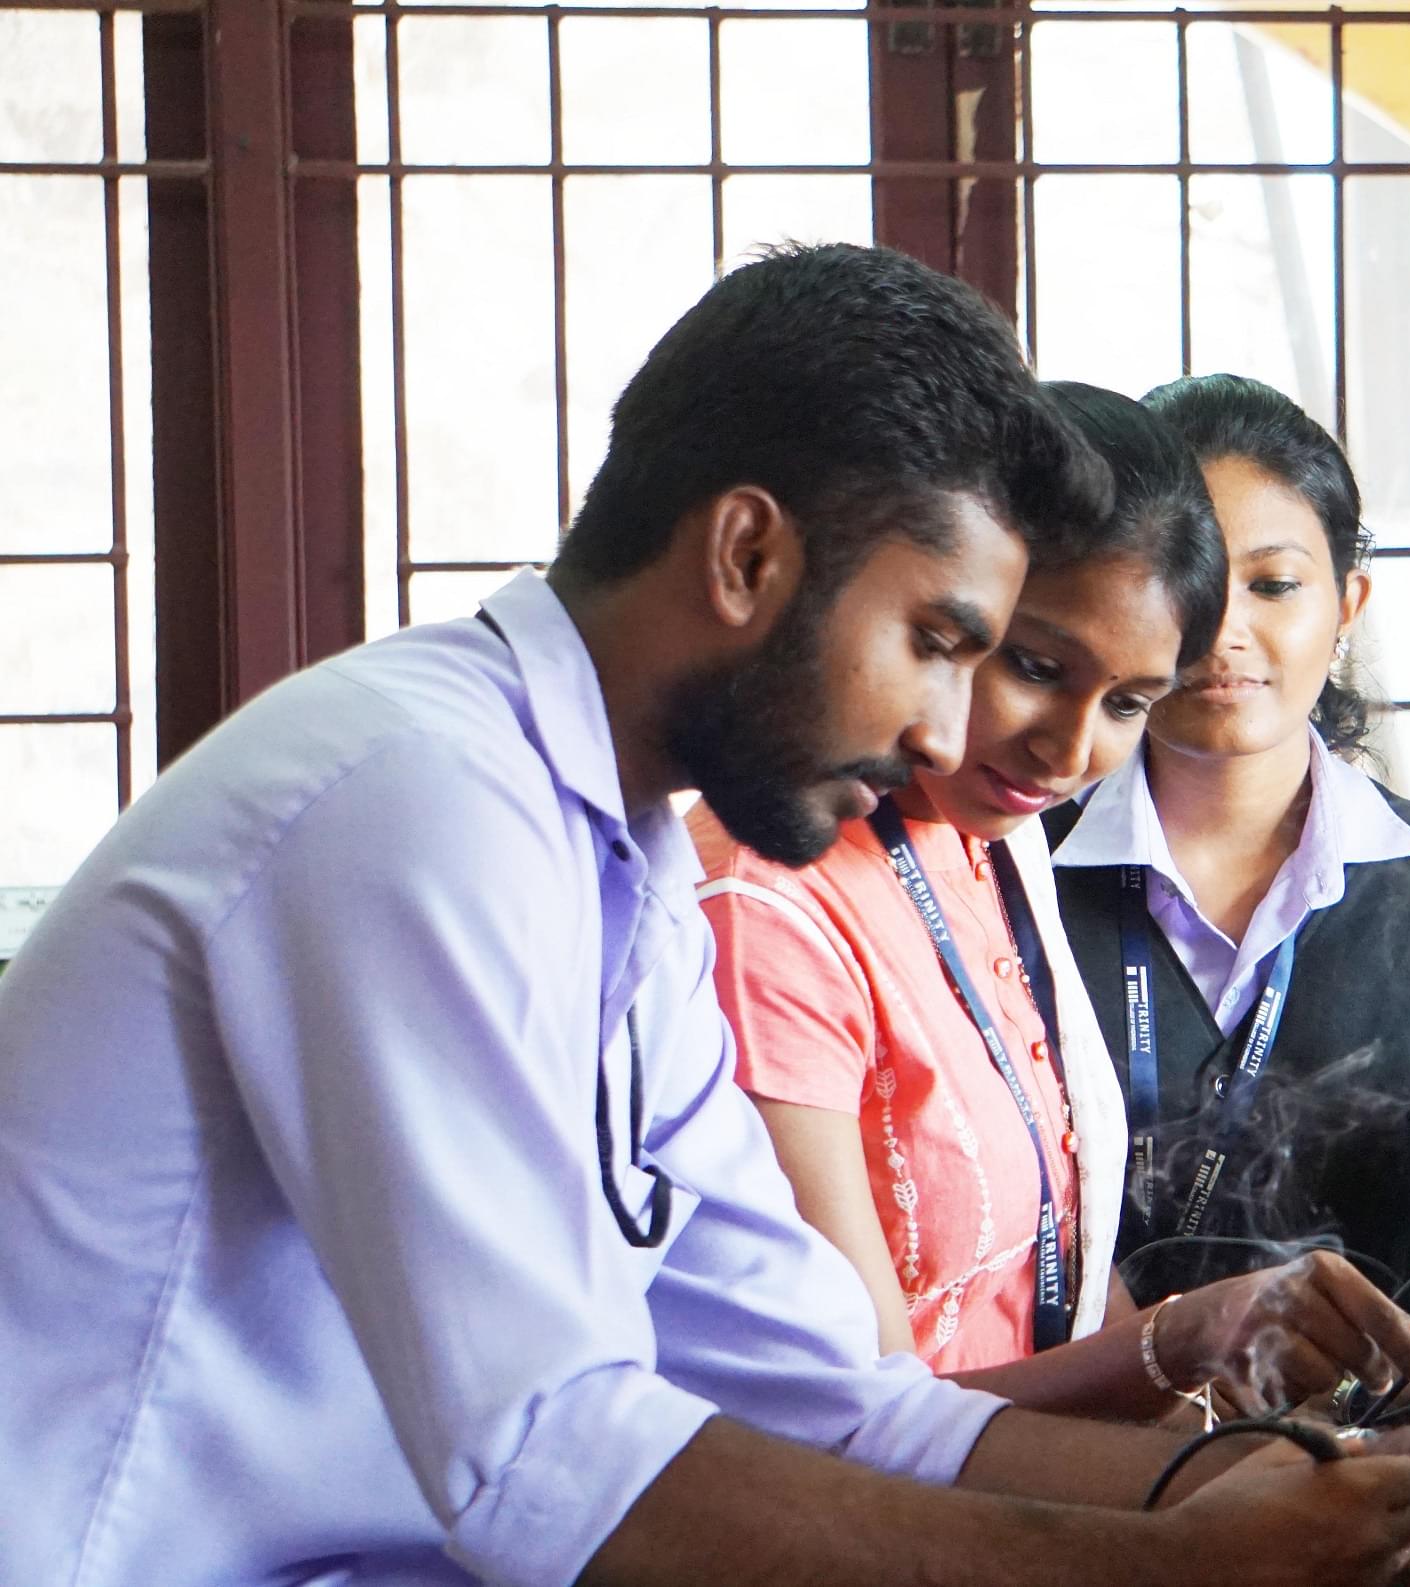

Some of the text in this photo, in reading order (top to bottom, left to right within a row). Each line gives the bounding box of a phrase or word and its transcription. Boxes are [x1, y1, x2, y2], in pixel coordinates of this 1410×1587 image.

[910, 868, 951, 941] TRINITY
[1138, 1002, 1151, 1055] TRINITY
[1247, 1025, 1272, 1077] TRINITY
[1184, 1189, 1211, 1237] TRINITY
[1046, 1228, 1059, 1306] TRINITY
